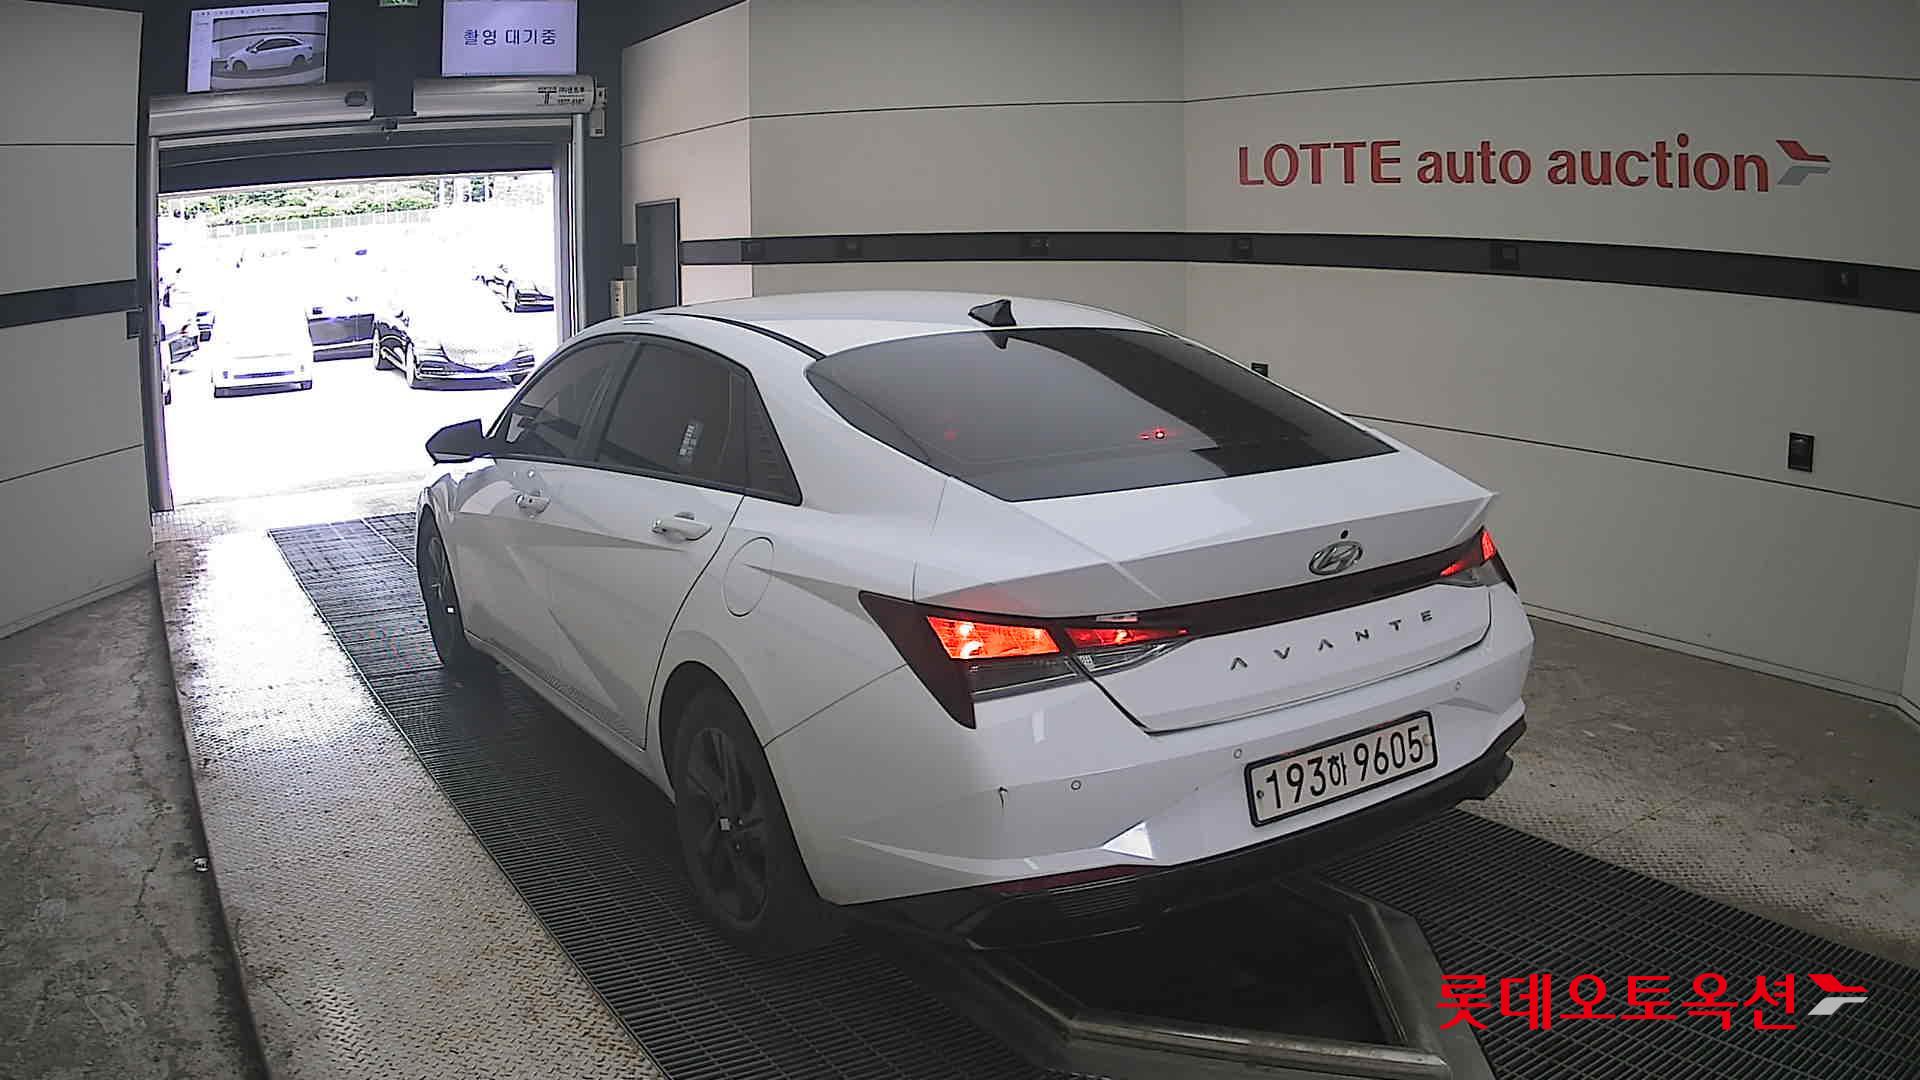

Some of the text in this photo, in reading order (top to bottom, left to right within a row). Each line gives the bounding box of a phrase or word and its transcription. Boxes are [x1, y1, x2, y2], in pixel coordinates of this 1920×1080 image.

[505, 29, 557, 46] 대기중
[1239, 133, 1769, 193] LOTTE auto auction
[1230, 610, 1433, 671] AVANTE
[1353, 725, 1424, 782] 9605
